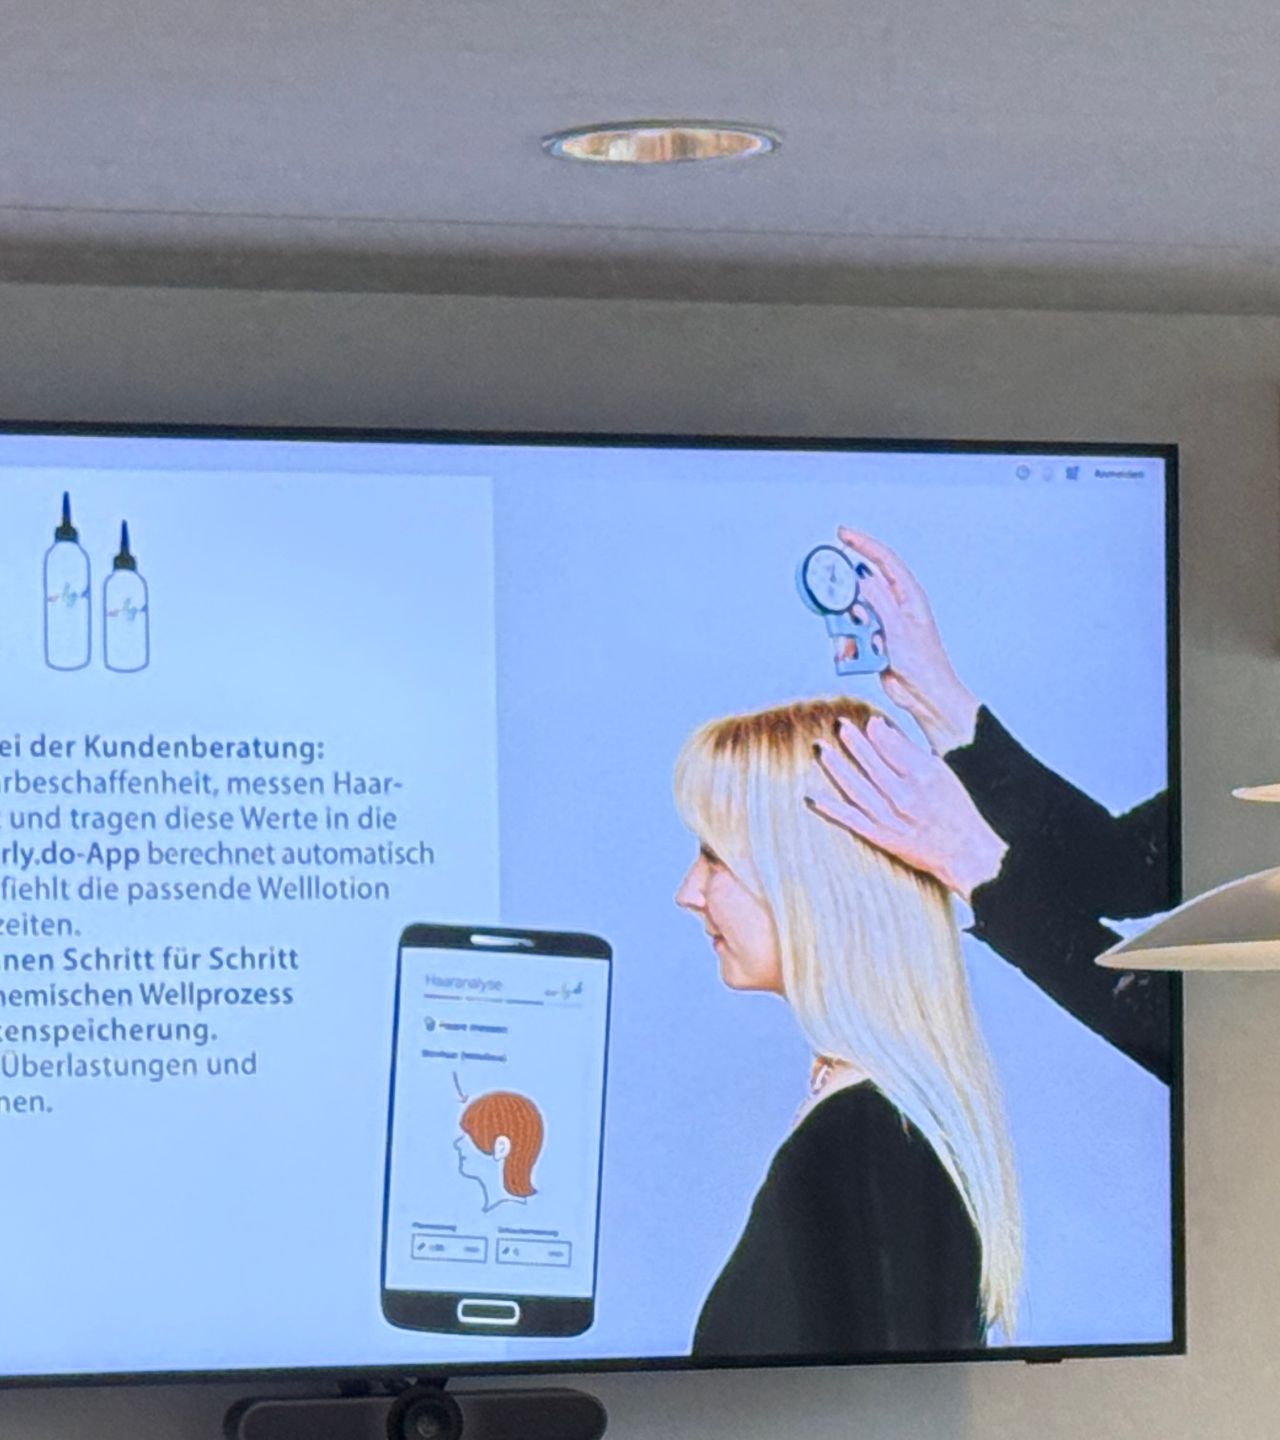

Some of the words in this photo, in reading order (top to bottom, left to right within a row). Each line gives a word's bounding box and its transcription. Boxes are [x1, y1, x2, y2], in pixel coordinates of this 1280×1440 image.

[29, 732, 77, 759] der
[84, 733, 325, 766] Kundenberatung:
[227, 775, 325, 796] messen
[333, 770, 403, 795] Haar-
[9, 805, 61, 830] und
[69, 808, 157, 836] tragen
[164, 805, 235, 831] diese
[239, 805, 319, 831] Werte
[325, 805, 349, 830] in
[357, 805, 398, 831] die
[147, 840, 276, 866] berechnet
[281, 840, 435, 866] automatisch
[77, 875, 119, 901] die
[127, 874, 252, 906] passende
[257, 875, 390, 901] Welllotion
[63, 946, 155, 972] Schritt
[162, 945, 202, 971] für
[208, 945, 299, 971] Schritt
[138, 981, 294, 1012] Wellprozess
[424, 972, 504, 993] Haaranalyse
[1, 1050, 198, 1083] Überlastungen
[207, 1051, 257, 1076] und
